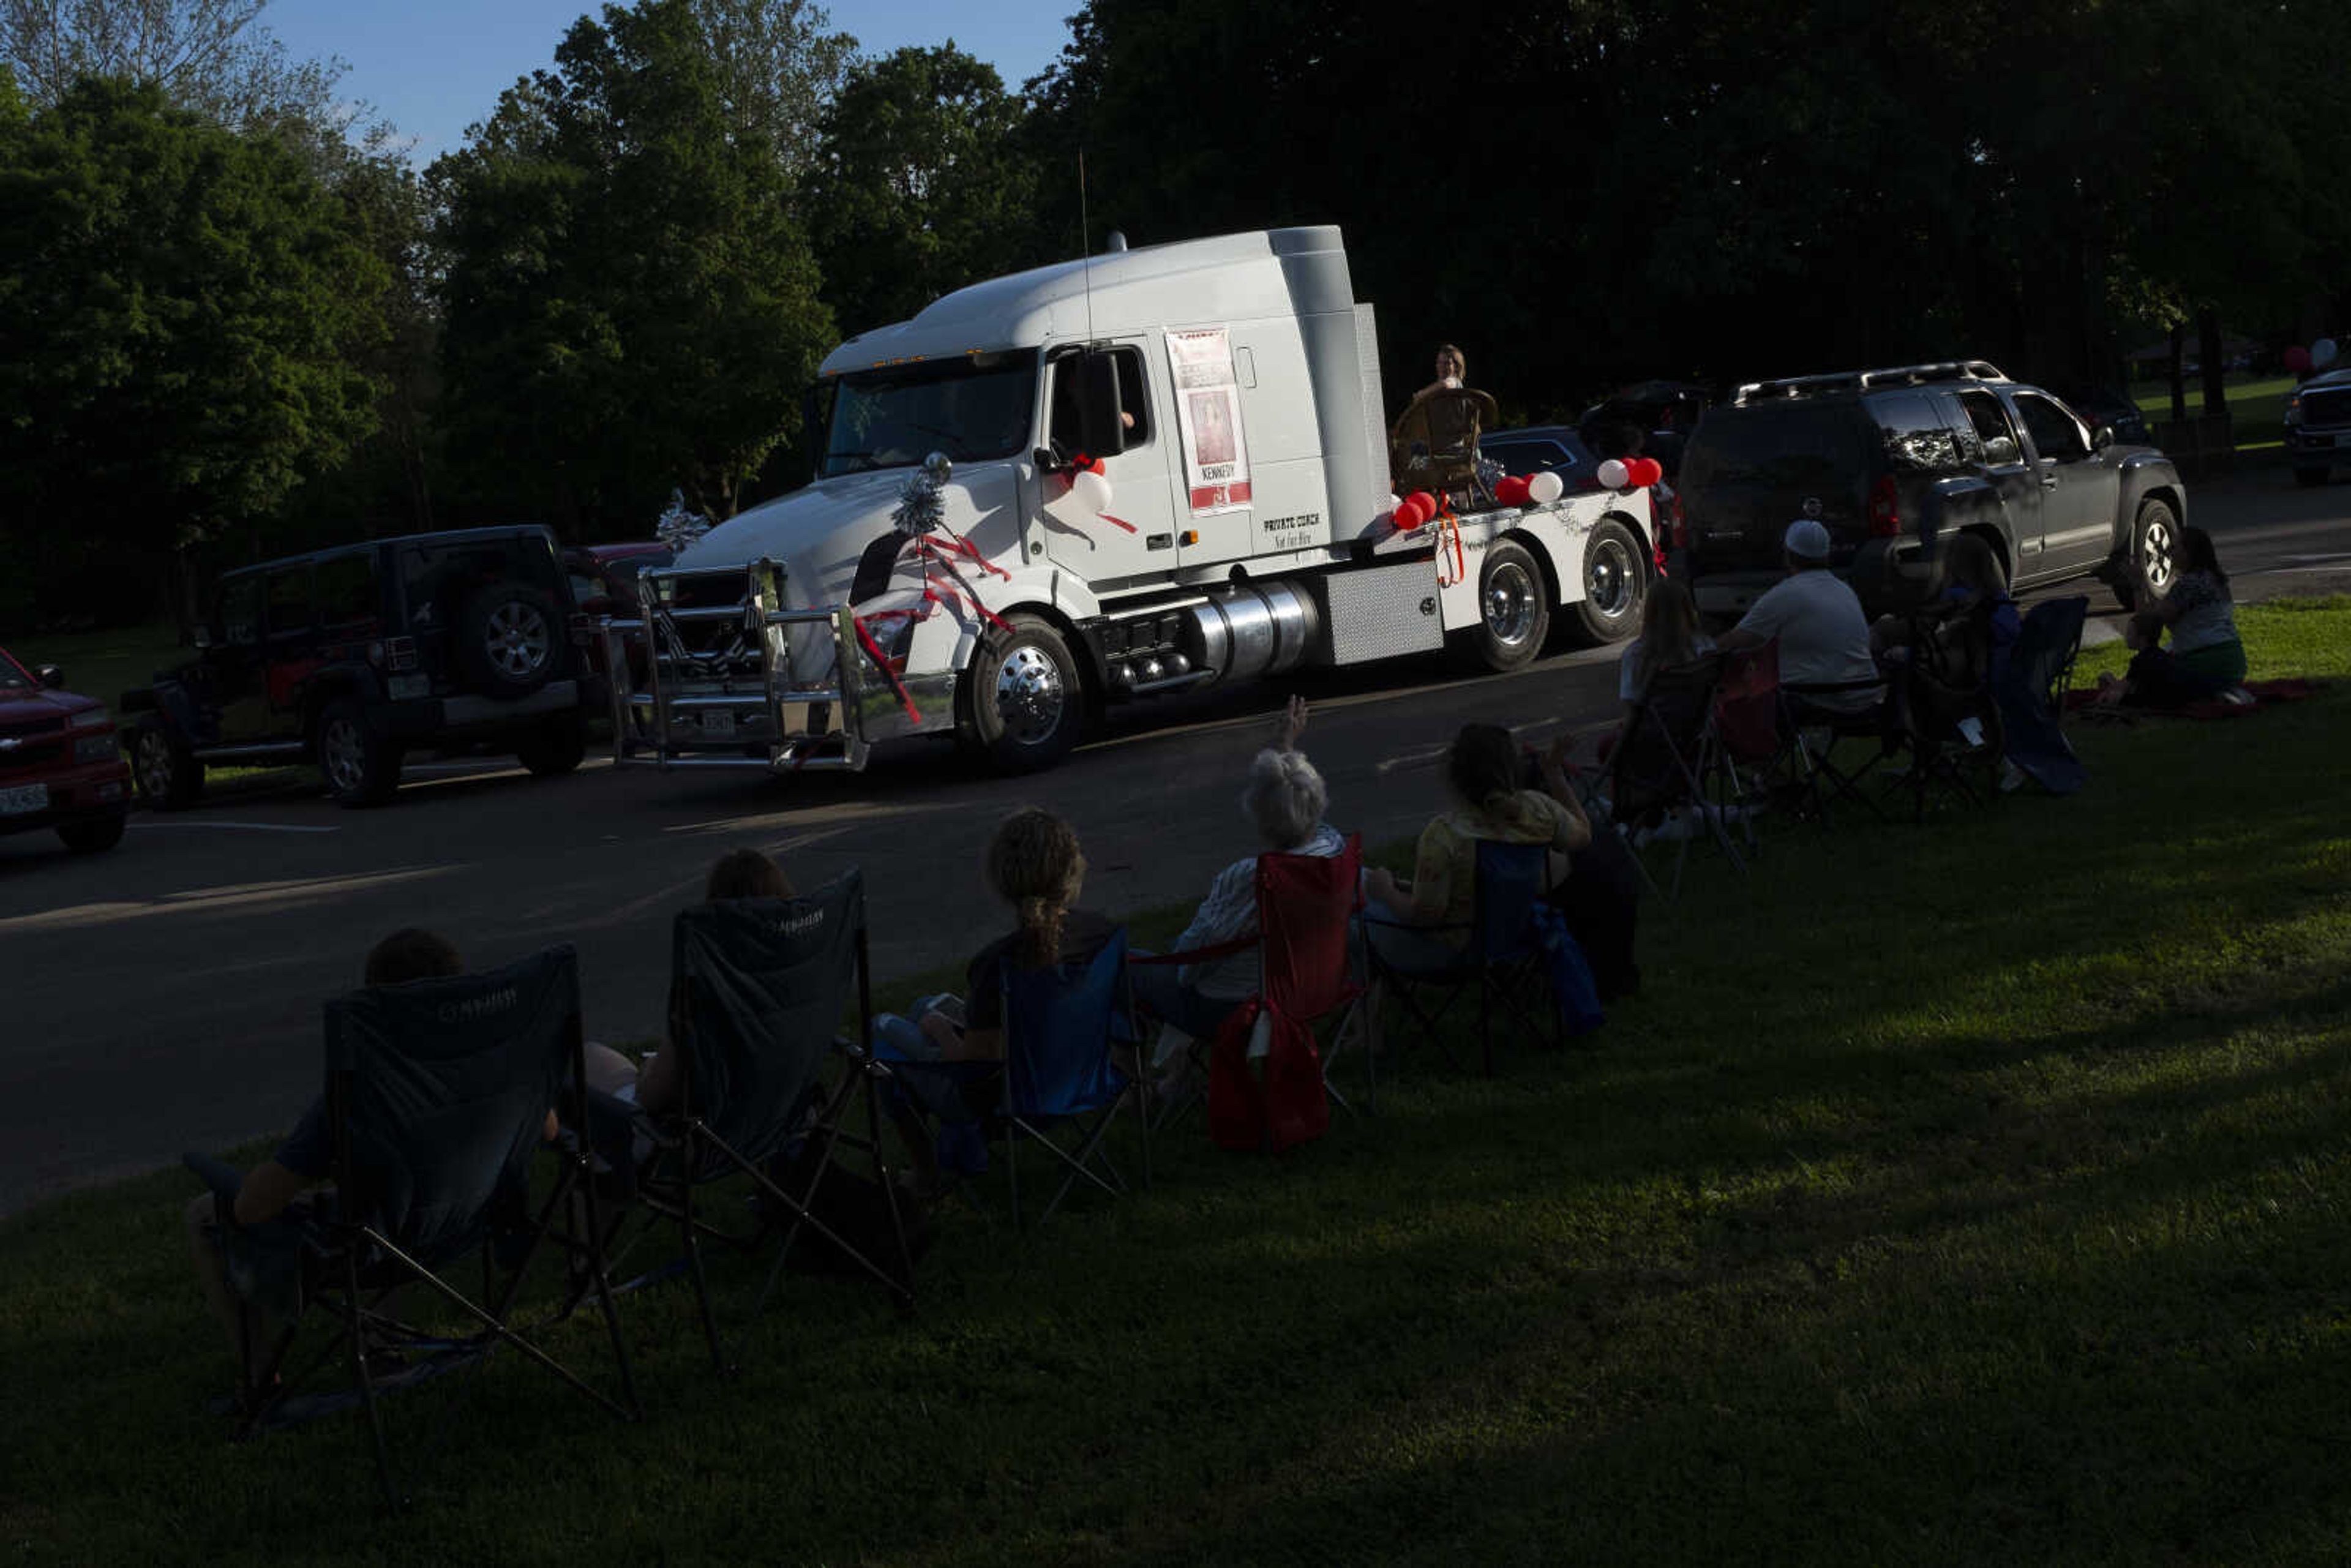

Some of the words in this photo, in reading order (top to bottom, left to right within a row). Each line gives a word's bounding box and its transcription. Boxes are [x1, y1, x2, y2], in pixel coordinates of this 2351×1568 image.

[1201, 464, 1235, 481] KENNEDY
[1264, 517, 1295, 532] PRIVATE
[1297, 512, 1319, 527] COACH
